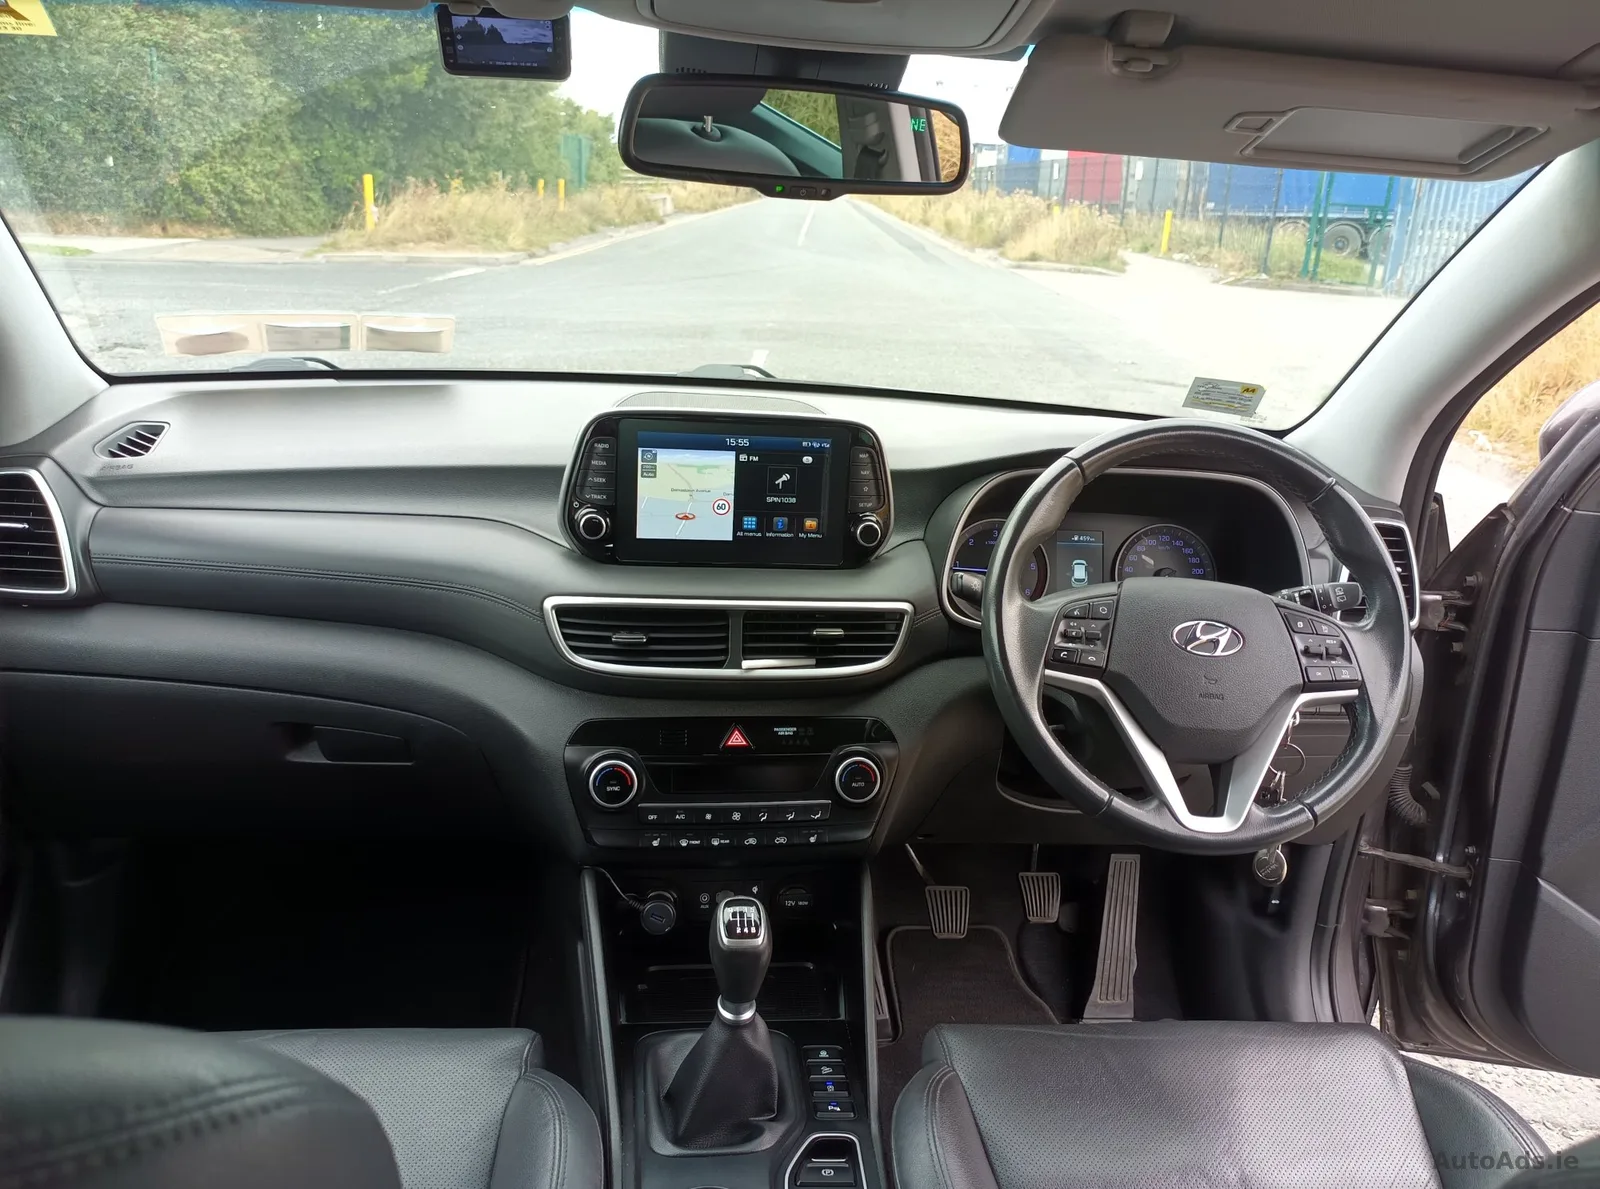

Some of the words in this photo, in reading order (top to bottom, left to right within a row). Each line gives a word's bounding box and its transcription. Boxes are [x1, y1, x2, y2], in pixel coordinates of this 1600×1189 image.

[911, 118, 926, 132] NE
[725, 438, 750, 447] 15:55
[766, 496, 796, 504] SPIN1038
[716, 502, 727, 511] 60
[992, 530, 998, 538] 3
[968, 538, 974, 546] 2
[1030, 562, 1036, 570] 5
[736, 926, 742, 934] 2
